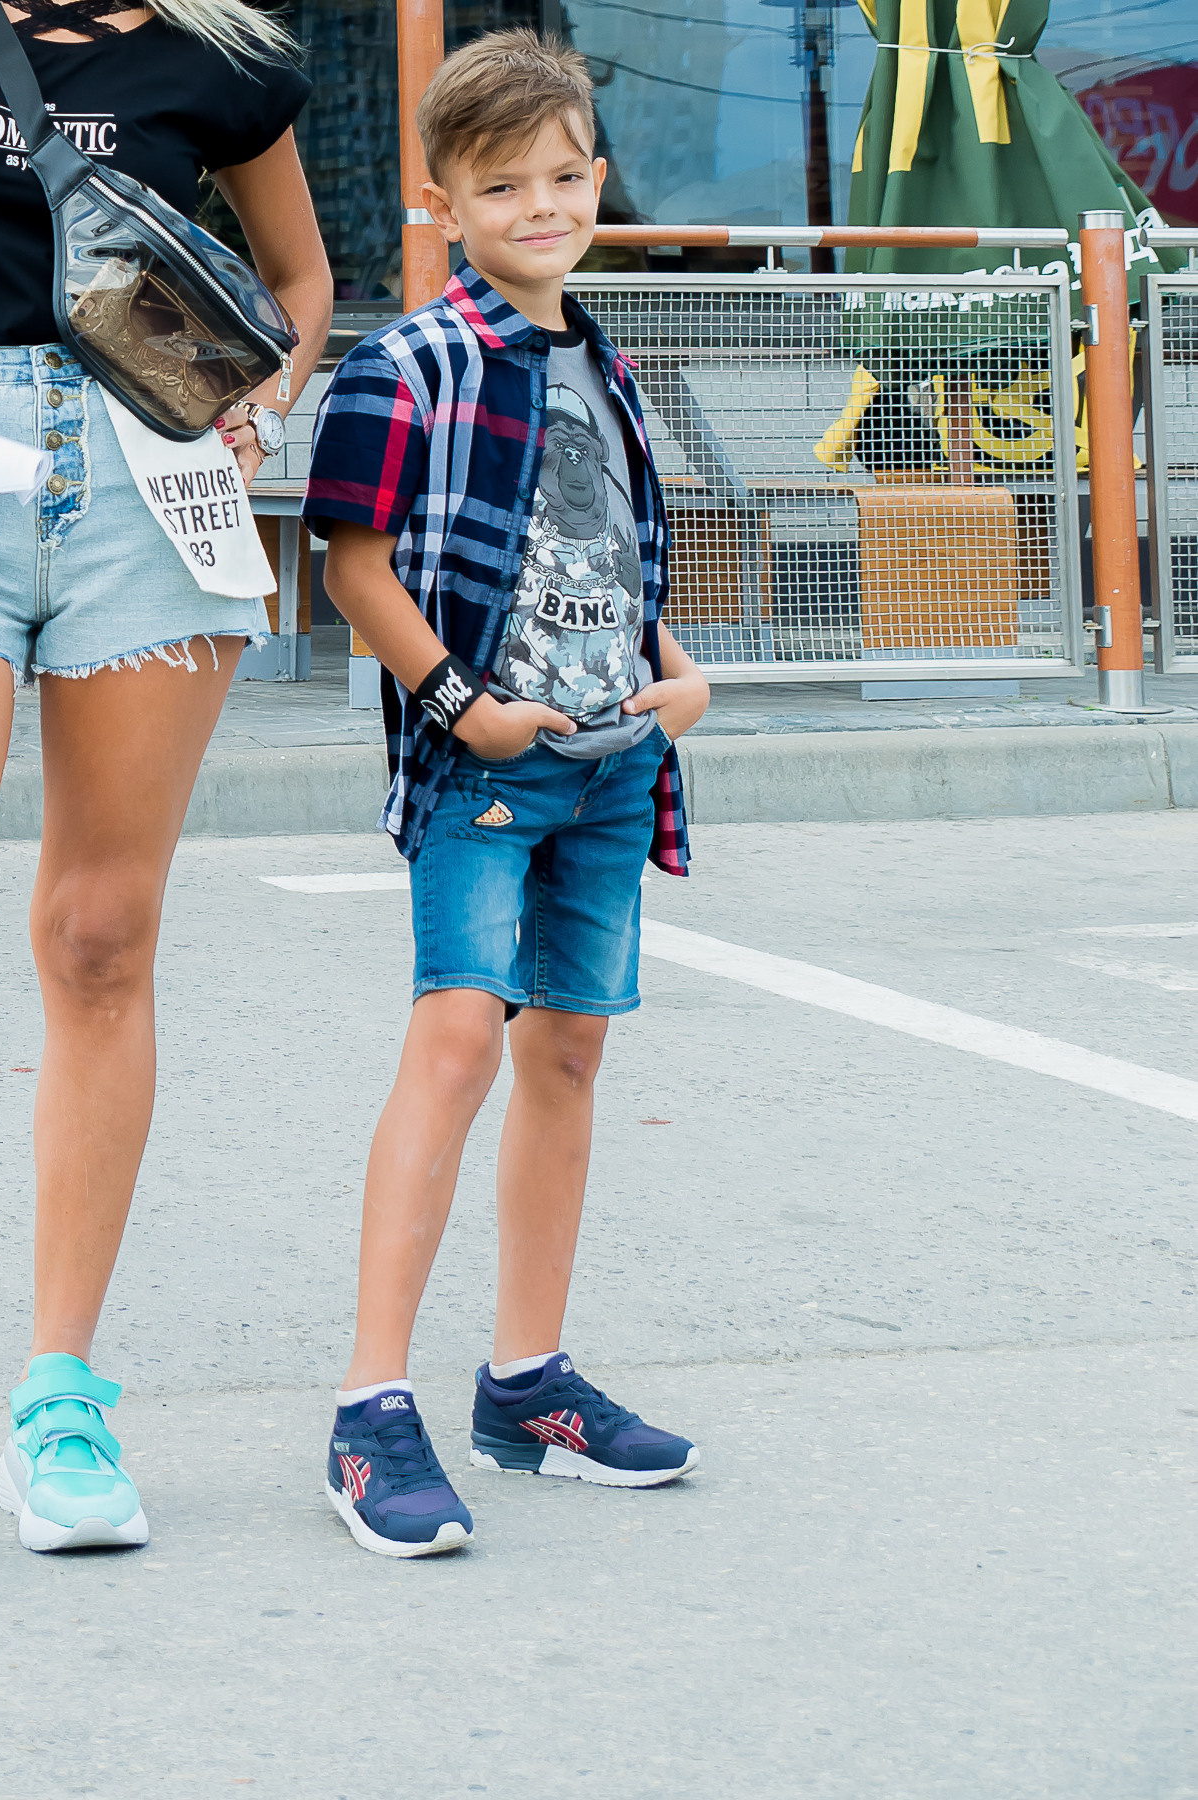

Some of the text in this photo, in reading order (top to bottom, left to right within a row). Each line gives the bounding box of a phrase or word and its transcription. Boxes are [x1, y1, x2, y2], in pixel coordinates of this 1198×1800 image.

[6, 154, 20, 167] as
[146, 465, 238, 504] NEWDIRE
[163, 499, 240, 535] STREET
[540, 590, 617, 628] BANG
